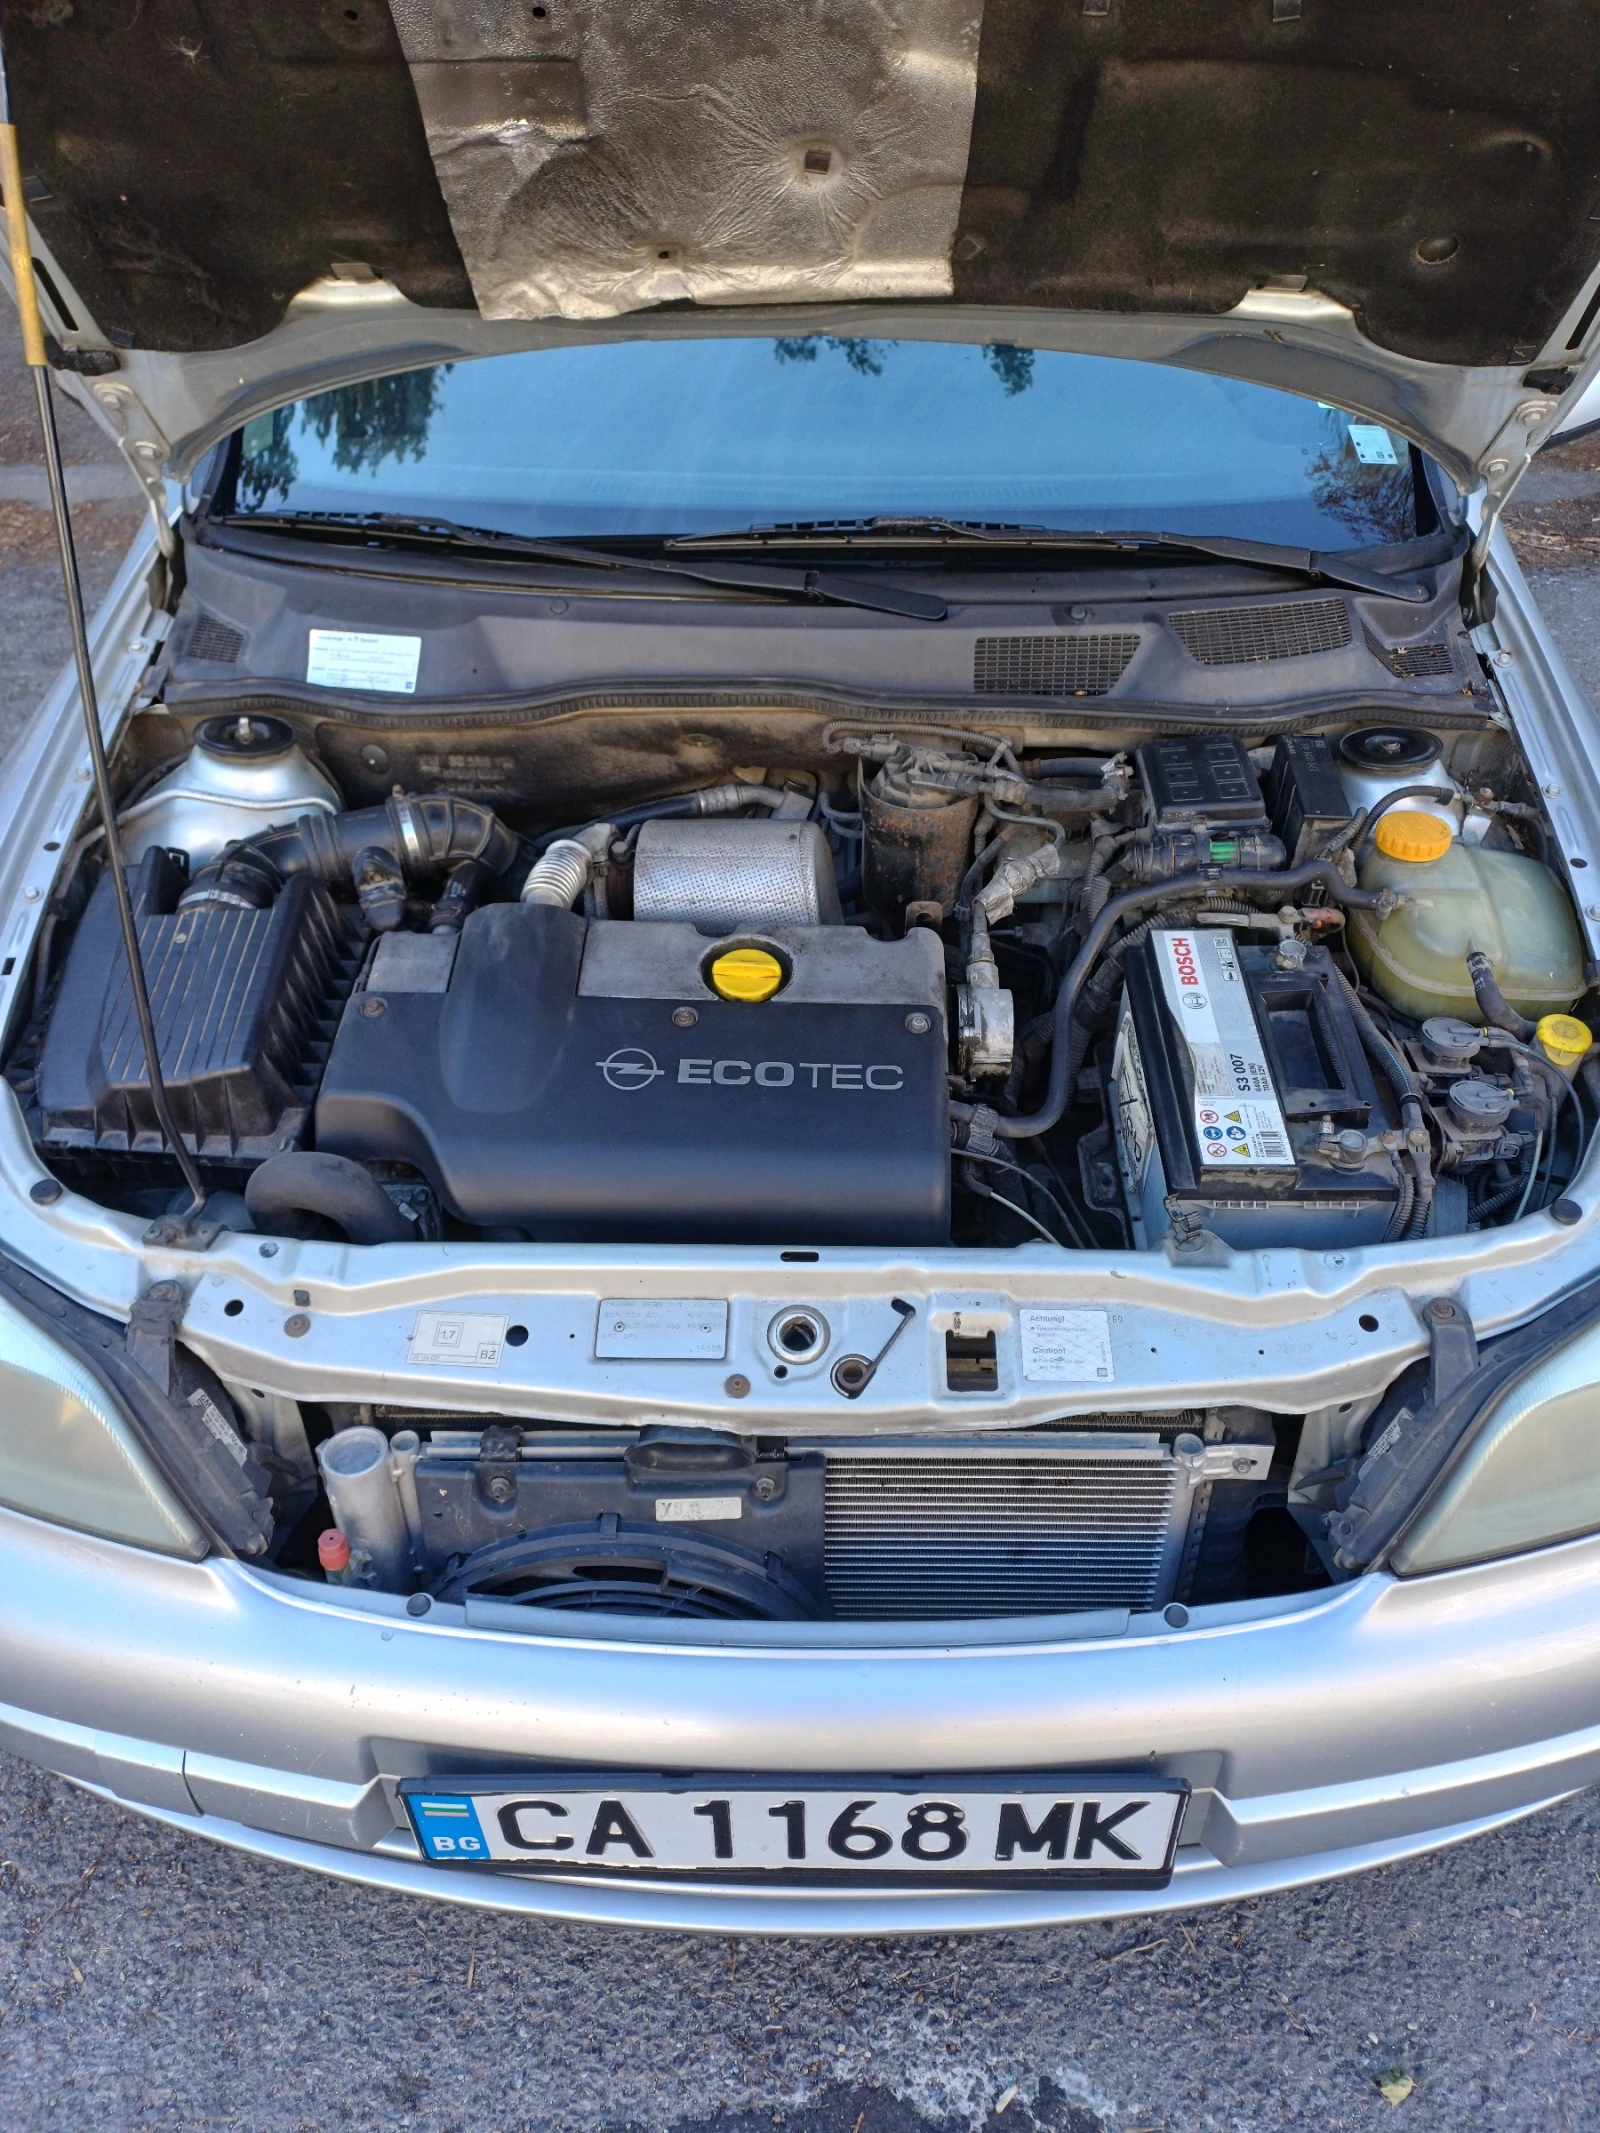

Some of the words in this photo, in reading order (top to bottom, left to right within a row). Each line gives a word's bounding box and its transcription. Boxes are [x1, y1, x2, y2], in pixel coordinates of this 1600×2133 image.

[1171, 938, 1199, 985] BOSCH
[1230, 1053, 1246, 1074] 007
[1236, 1077, 1251, 1092] S3
[440, 1330, 456, 1340] 1,7
[480, 1349, 497, 1360] BZ
[1032, 1346, 1066, 1354] Caution!
[200, 1394, 213, 1409] GM
[496, 1799, 656, 1858] CA
[693, 1799, 968, 1861] 1168
[994, 1801, 1151, 1861] MK
[432, 1835, 481, 1851] BG
